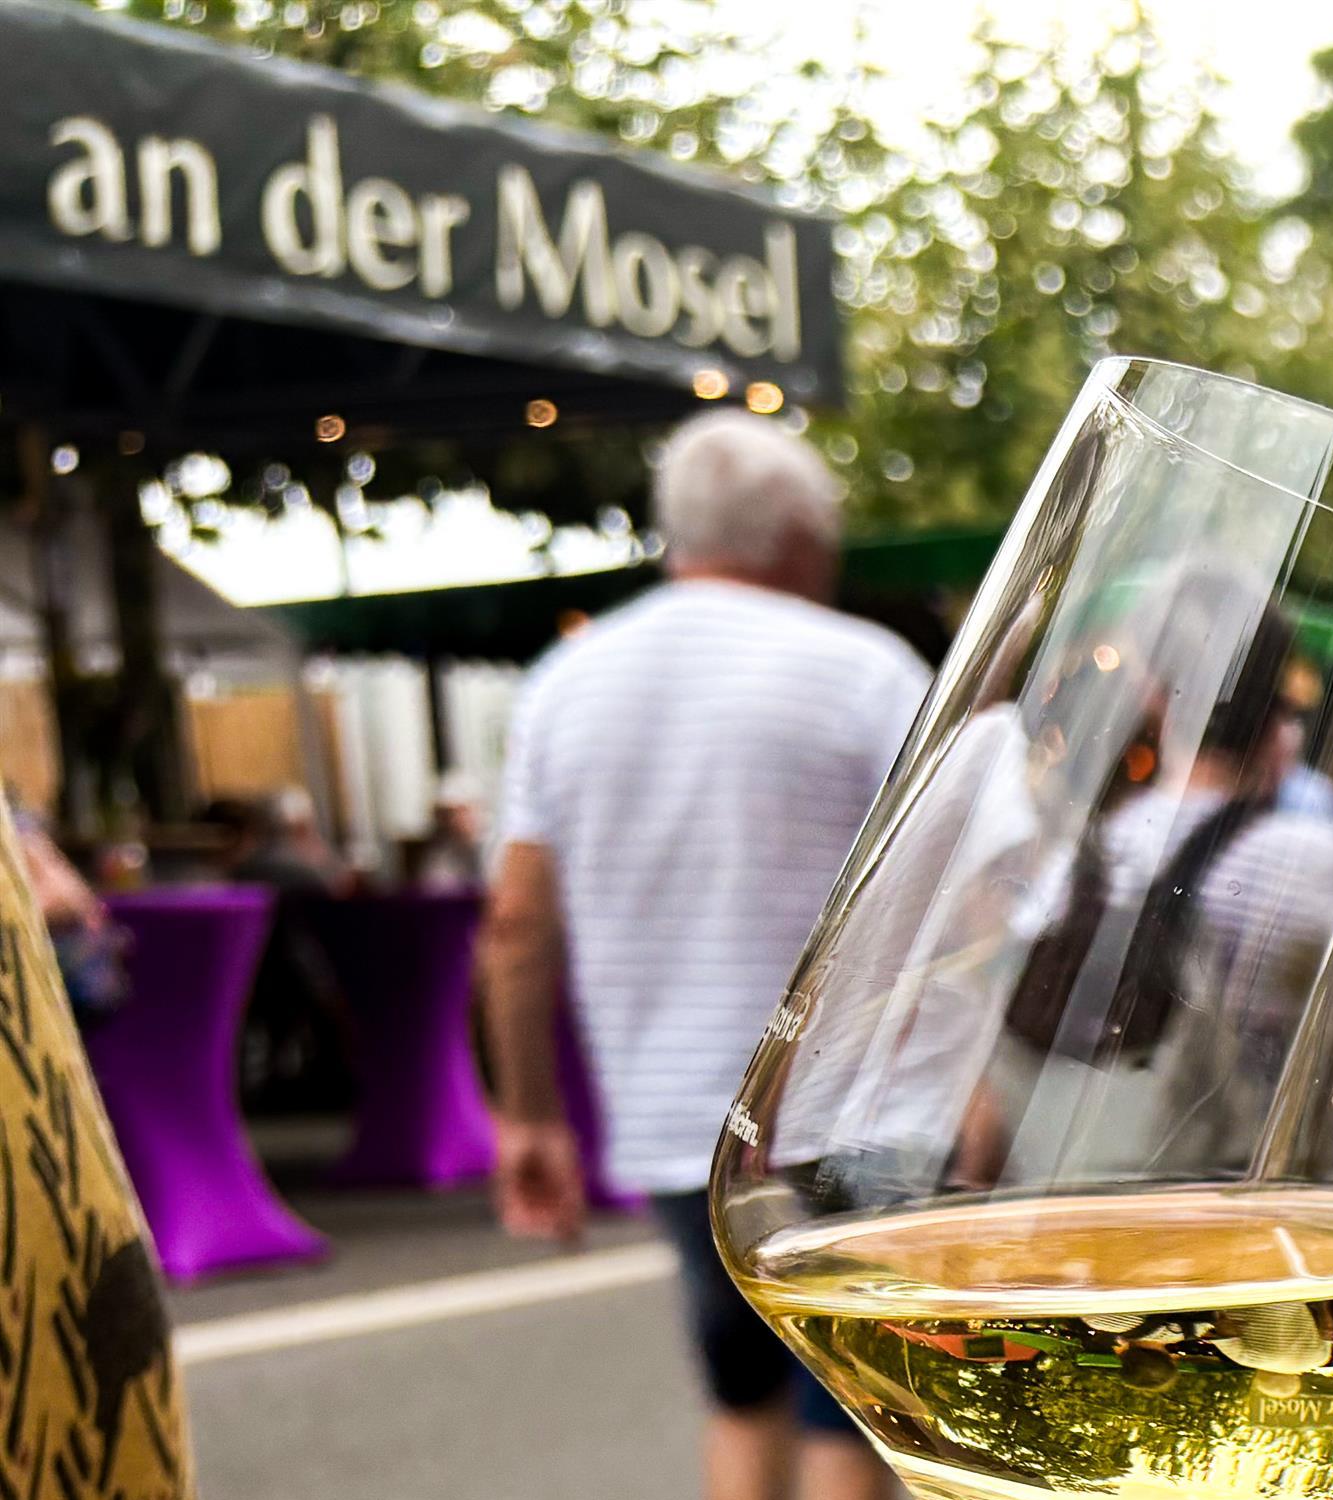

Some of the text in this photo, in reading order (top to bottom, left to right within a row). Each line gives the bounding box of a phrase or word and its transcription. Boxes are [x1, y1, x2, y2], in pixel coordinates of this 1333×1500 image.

[46, 111, 802, 363] an der Mosel
[1259, 1398, 1322, 1423] Mosel
